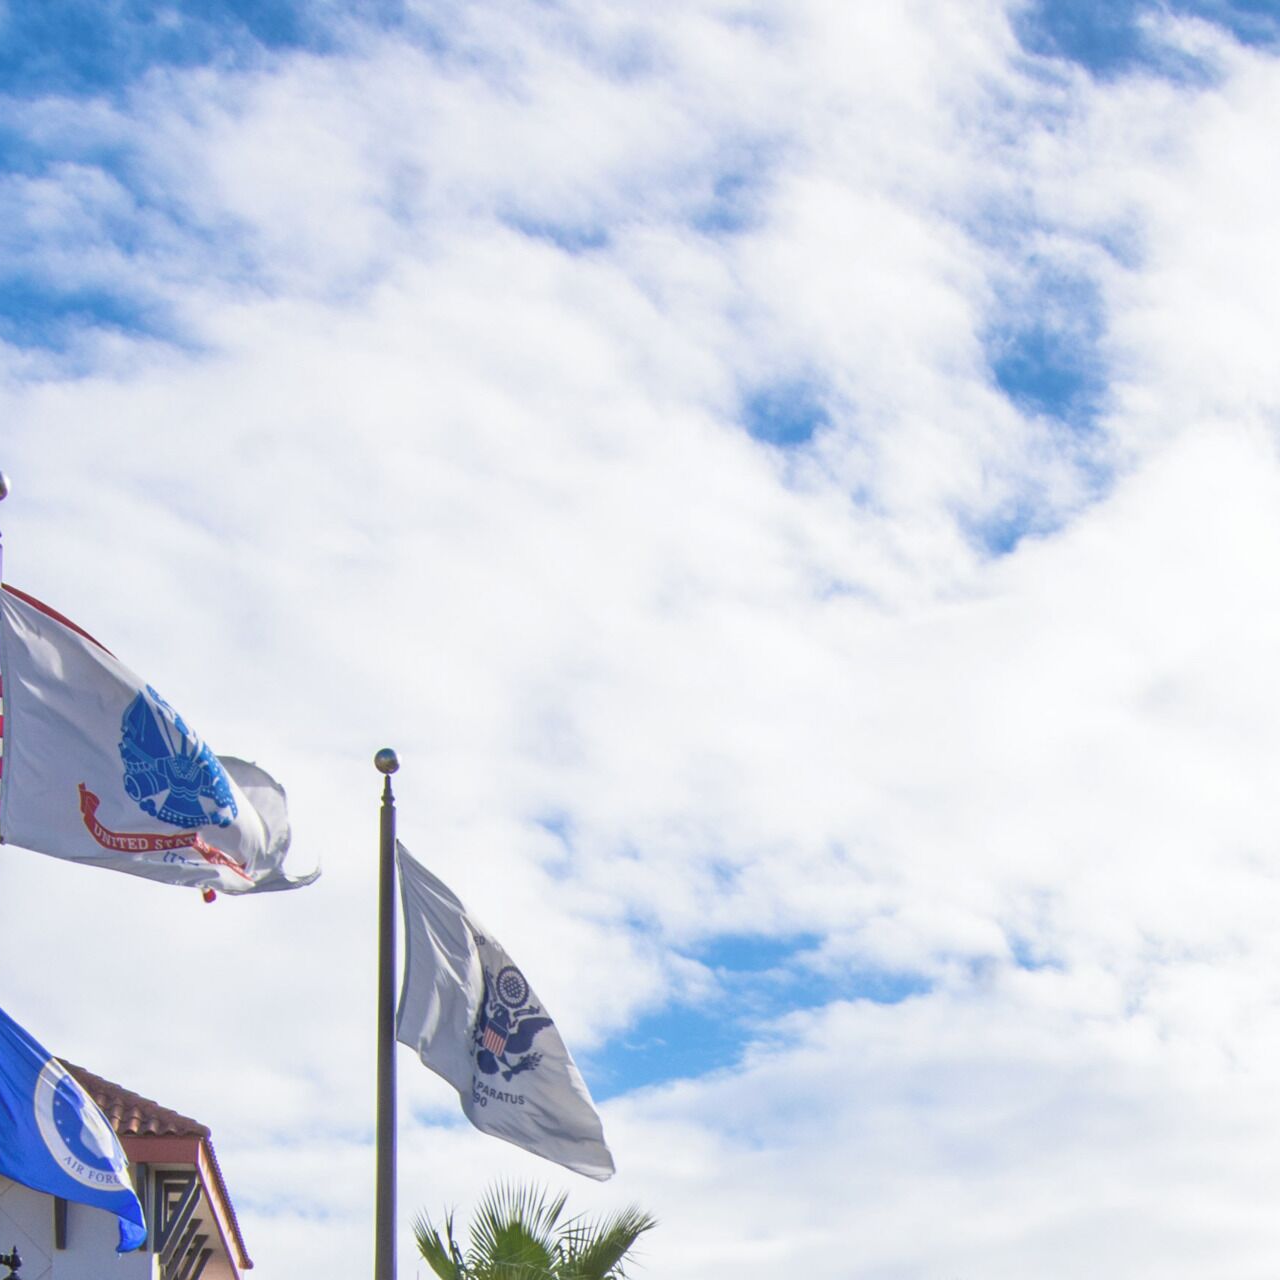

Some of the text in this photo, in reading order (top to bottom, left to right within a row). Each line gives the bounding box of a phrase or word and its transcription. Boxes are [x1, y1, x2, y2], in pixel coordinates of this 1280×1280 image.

[93, 823, 149, 850] UNITED
[477, 1080, 525, 1105] PARATUS
[64, 1156, 84, 1175] AIR
